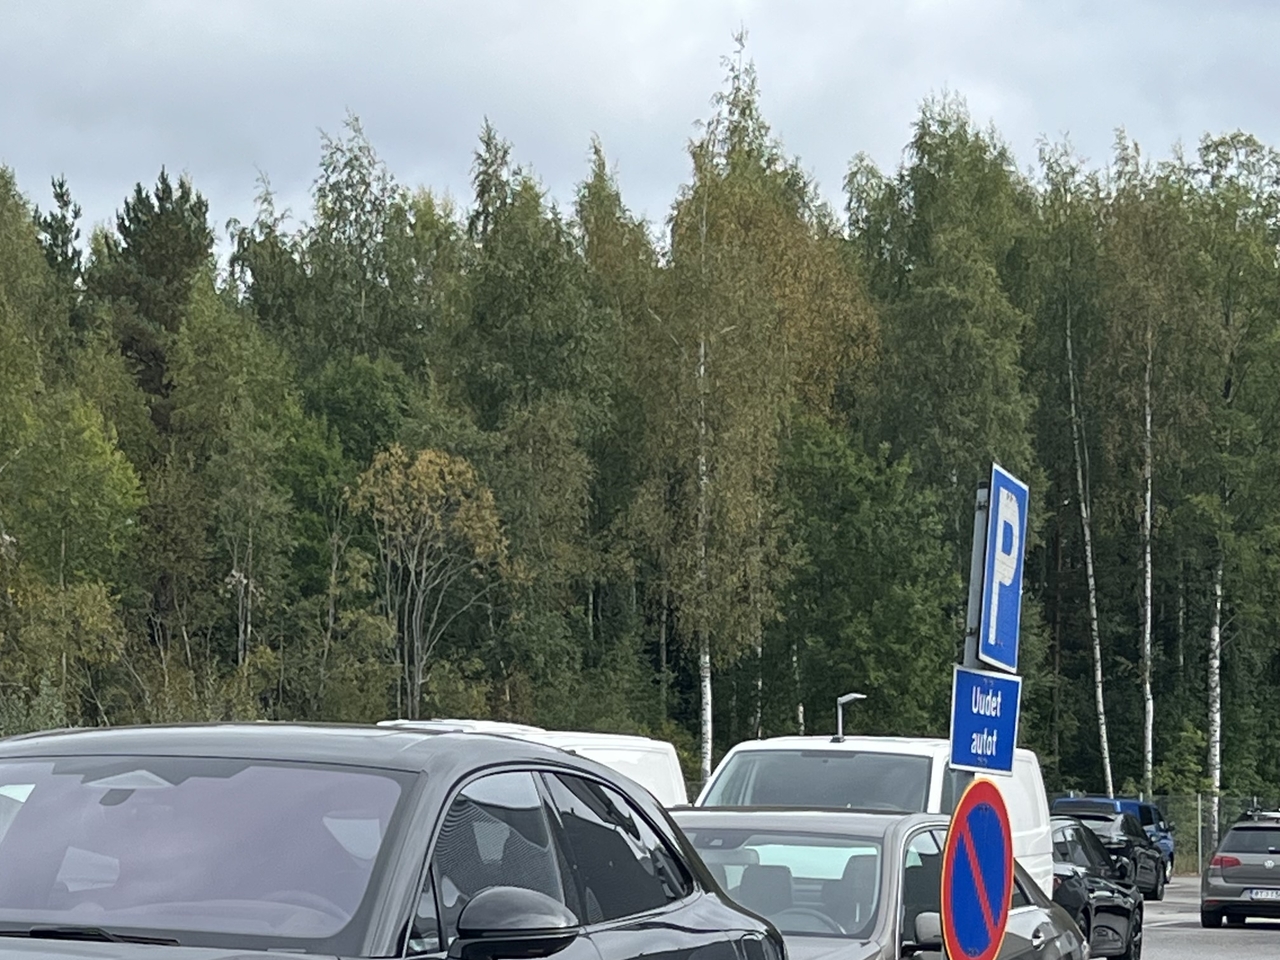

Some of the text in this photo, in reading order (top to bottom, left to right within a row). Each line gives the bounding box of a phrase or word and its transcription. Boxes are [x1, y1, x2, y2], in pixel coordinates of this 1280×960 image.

[988, 486, 1020, 645] P
[971, 686, 1002, 717] Uudet
[970, 727, 998, 757] autot
